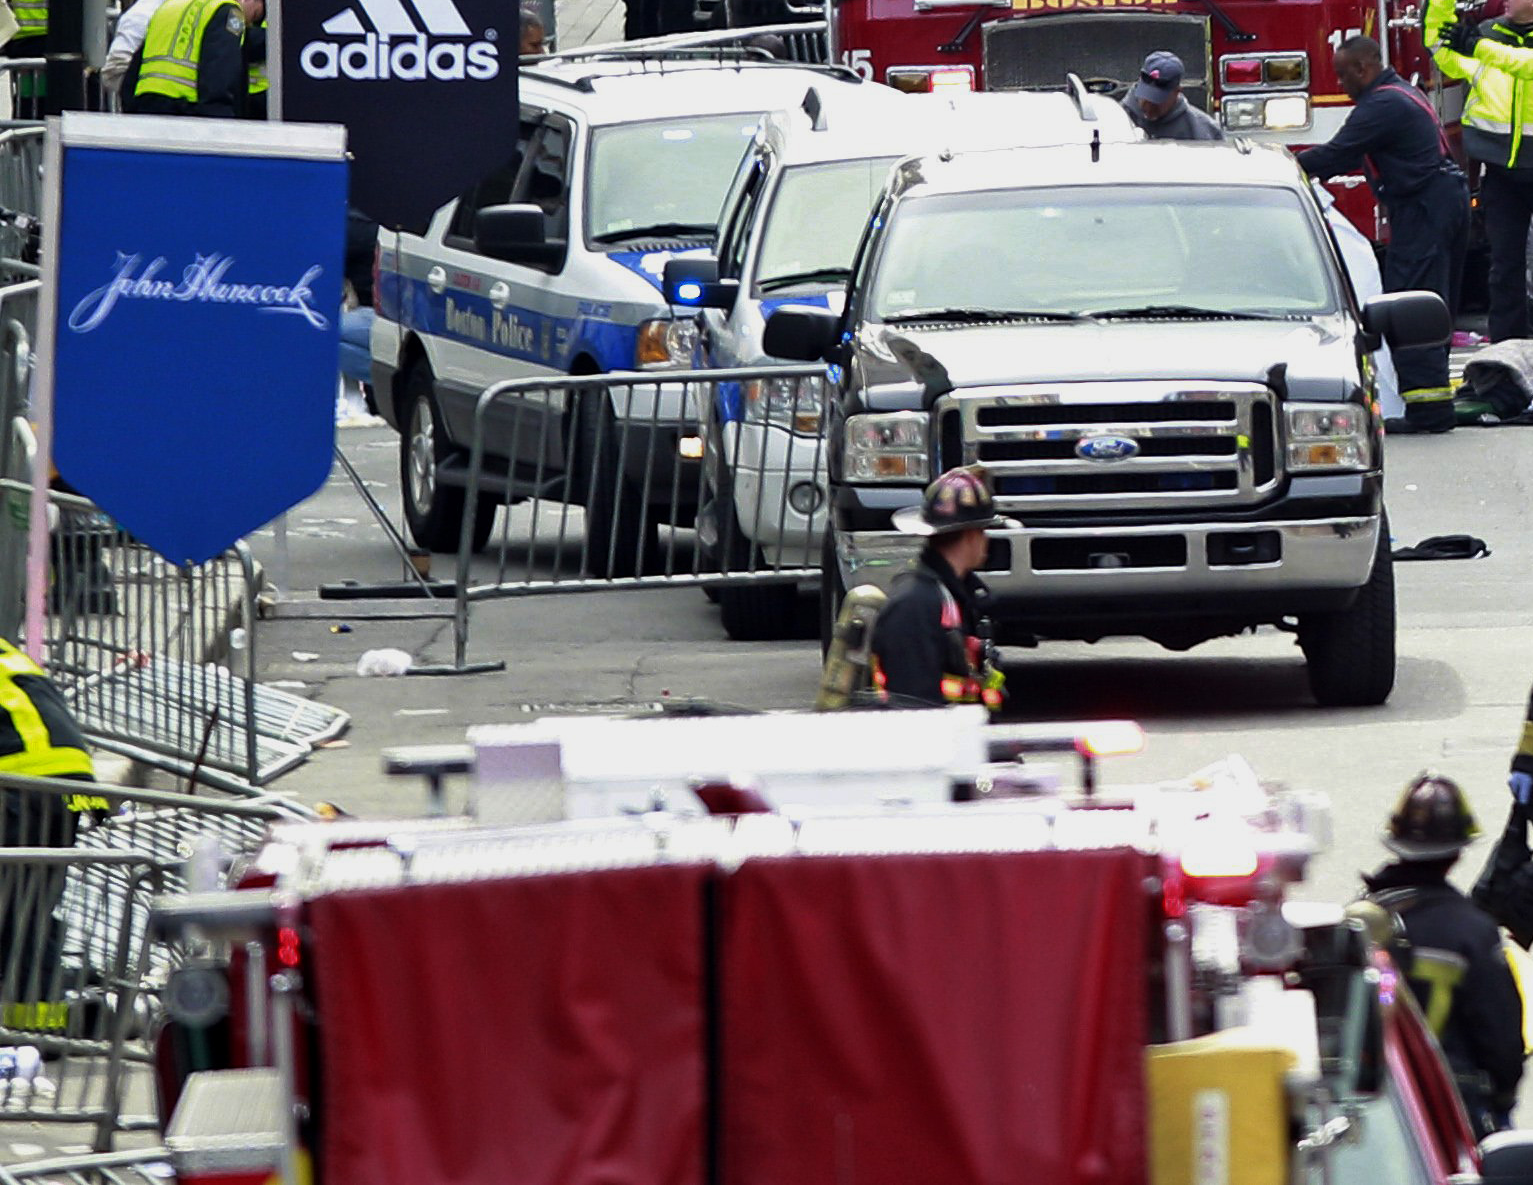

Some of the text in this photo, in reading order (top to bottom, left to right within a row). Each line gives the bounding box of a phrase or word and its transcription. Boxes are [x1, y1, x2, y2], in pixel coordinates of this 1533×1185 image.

[300, 32, 500, 80] adidas
[842, 49, 874, 81] 15
[68, 250, 331, 333] John Hancock
[446, 296, 487, 342] Boston
[492, 307, 534, 352] Police
